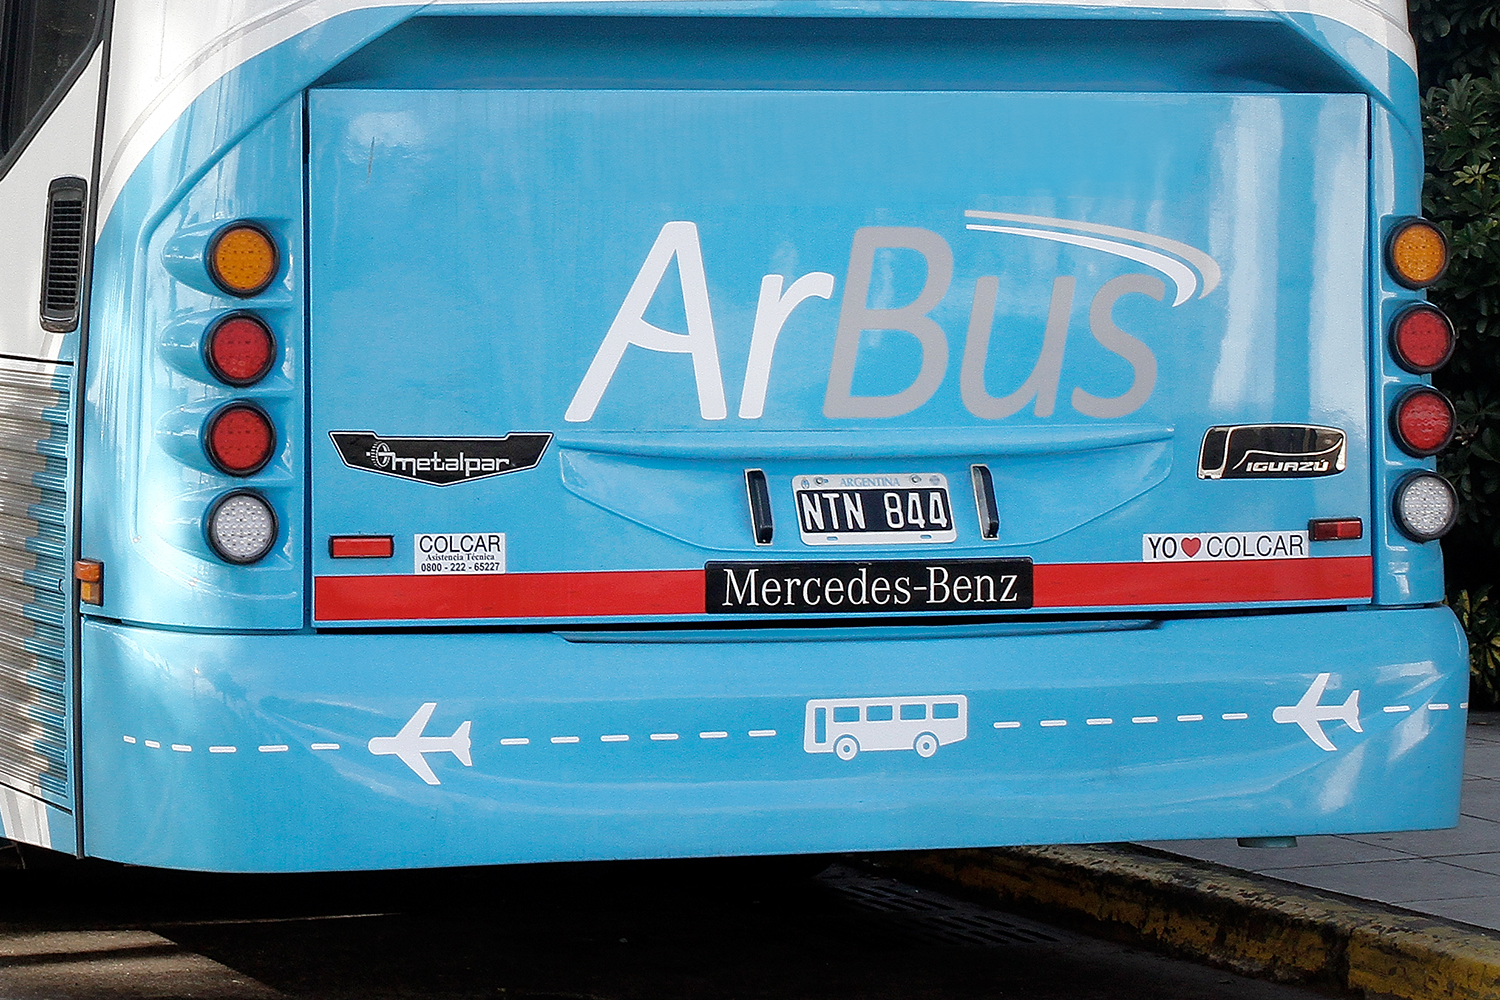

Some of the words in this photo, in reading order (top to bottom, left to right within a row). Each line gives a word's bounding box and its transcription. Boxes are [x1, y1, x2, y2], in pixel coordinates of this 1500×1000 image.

[564, 220, 1166, 422] ArBus
[390, 451, 510, 477] metalpar
[1245, 459, 1330, 472] IGUAZÚ
[840, 477, 901, 487] ARGENTINA
[801, 492, 865, 530] NTN
[884, 491, 948, 528] 844
[419, 535, 501, 553] COLCAR
[1147, 536, 1177, 558] YO
[1206, 535, 1304, 557] COLCAR
[425, 553, 464, 561] Asistencia
[465, 552, 495, 561] Técnica
[421, 563, 442, 572] 0800
[450, 562, 466, 572] 222
[474, 562, 500, 571] 65227
[722, 566, 1019, 607] Mercedes-Benz
